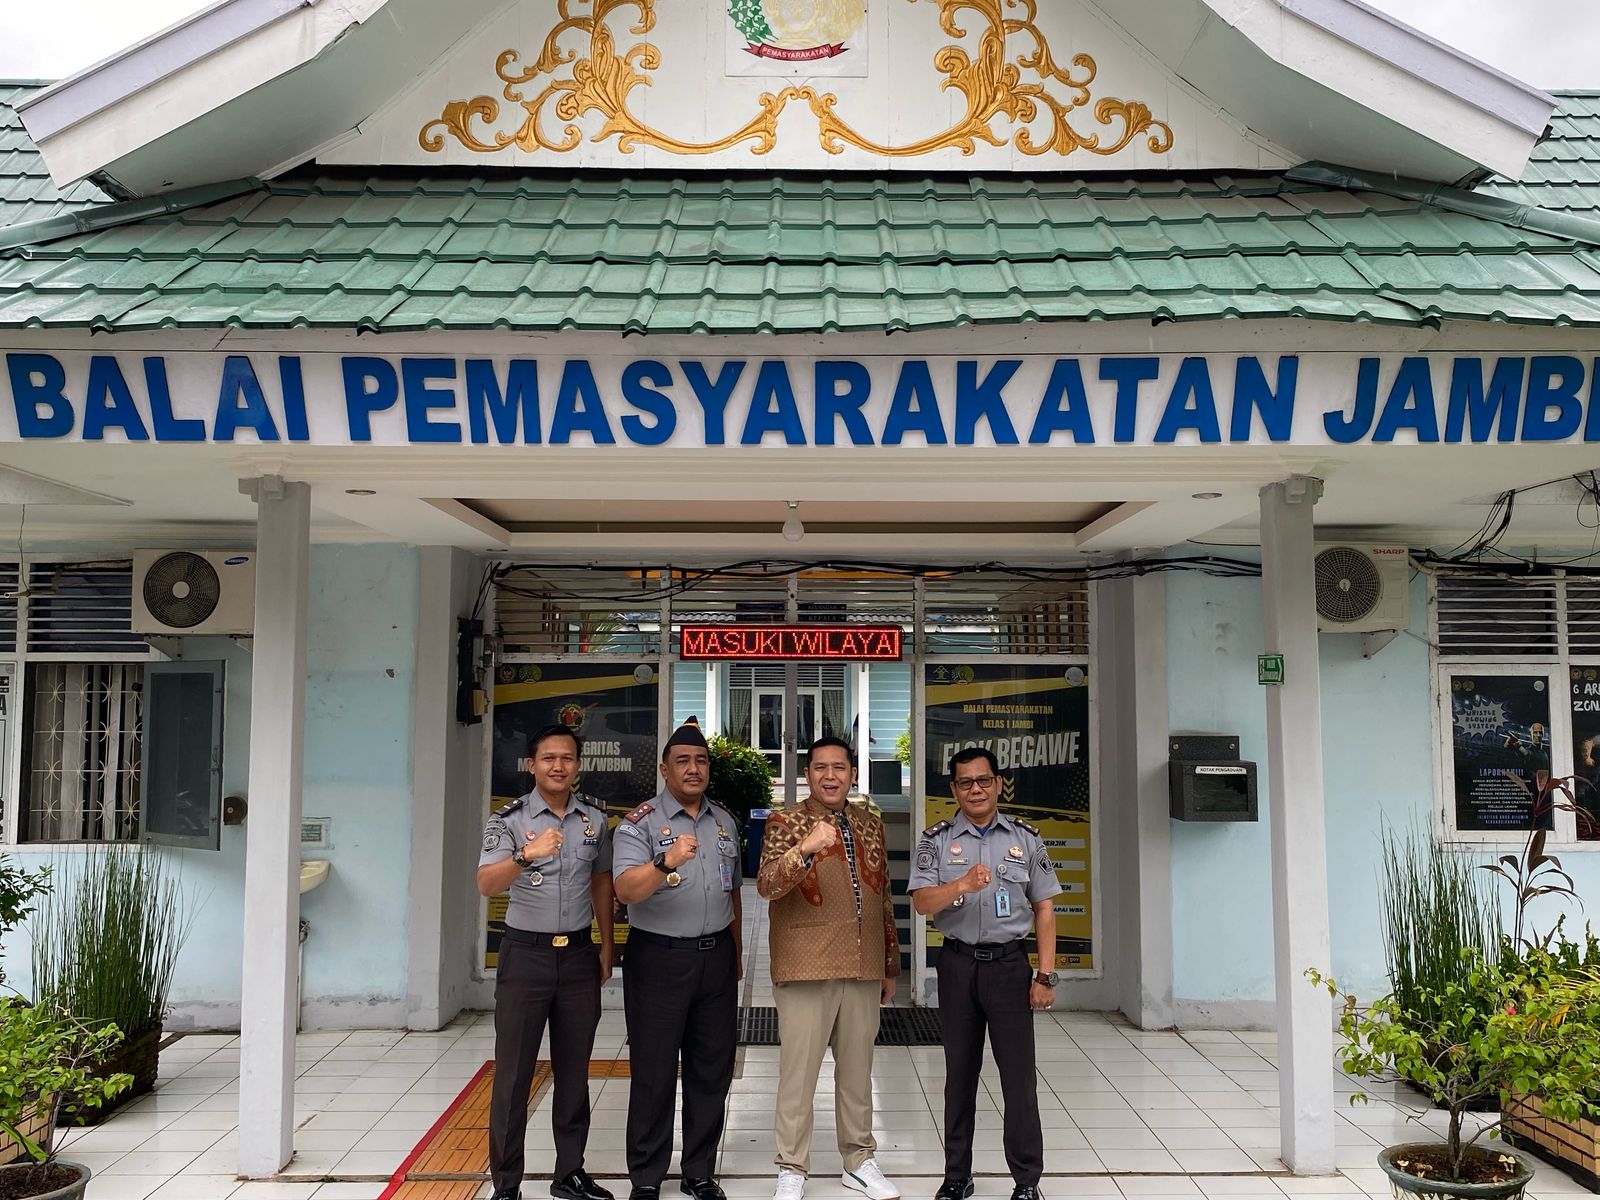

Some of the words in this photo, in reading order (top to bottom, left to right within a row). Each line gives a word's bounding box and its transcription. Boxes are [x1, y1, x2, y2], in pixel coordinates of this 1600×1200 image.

[762, 47, 830, 58] PEMASYARAKATAN
[5, 353, 310, 441] BALAI
[341, 355, 1300, 446] PEMASYARAKATAN
[685, 632, 783, 654] MASUKI
[1584, 682, 1600, 696] AR
[963, 704, 984, 713] BALAI
[985, 705, 1054, 715] PEMASYARAKATAN
[982, 720, 1005, 729] KELAS
[1011, 720, 1034, 729] JAMBI
[996, 731, 1080, 769] BEGAWE
